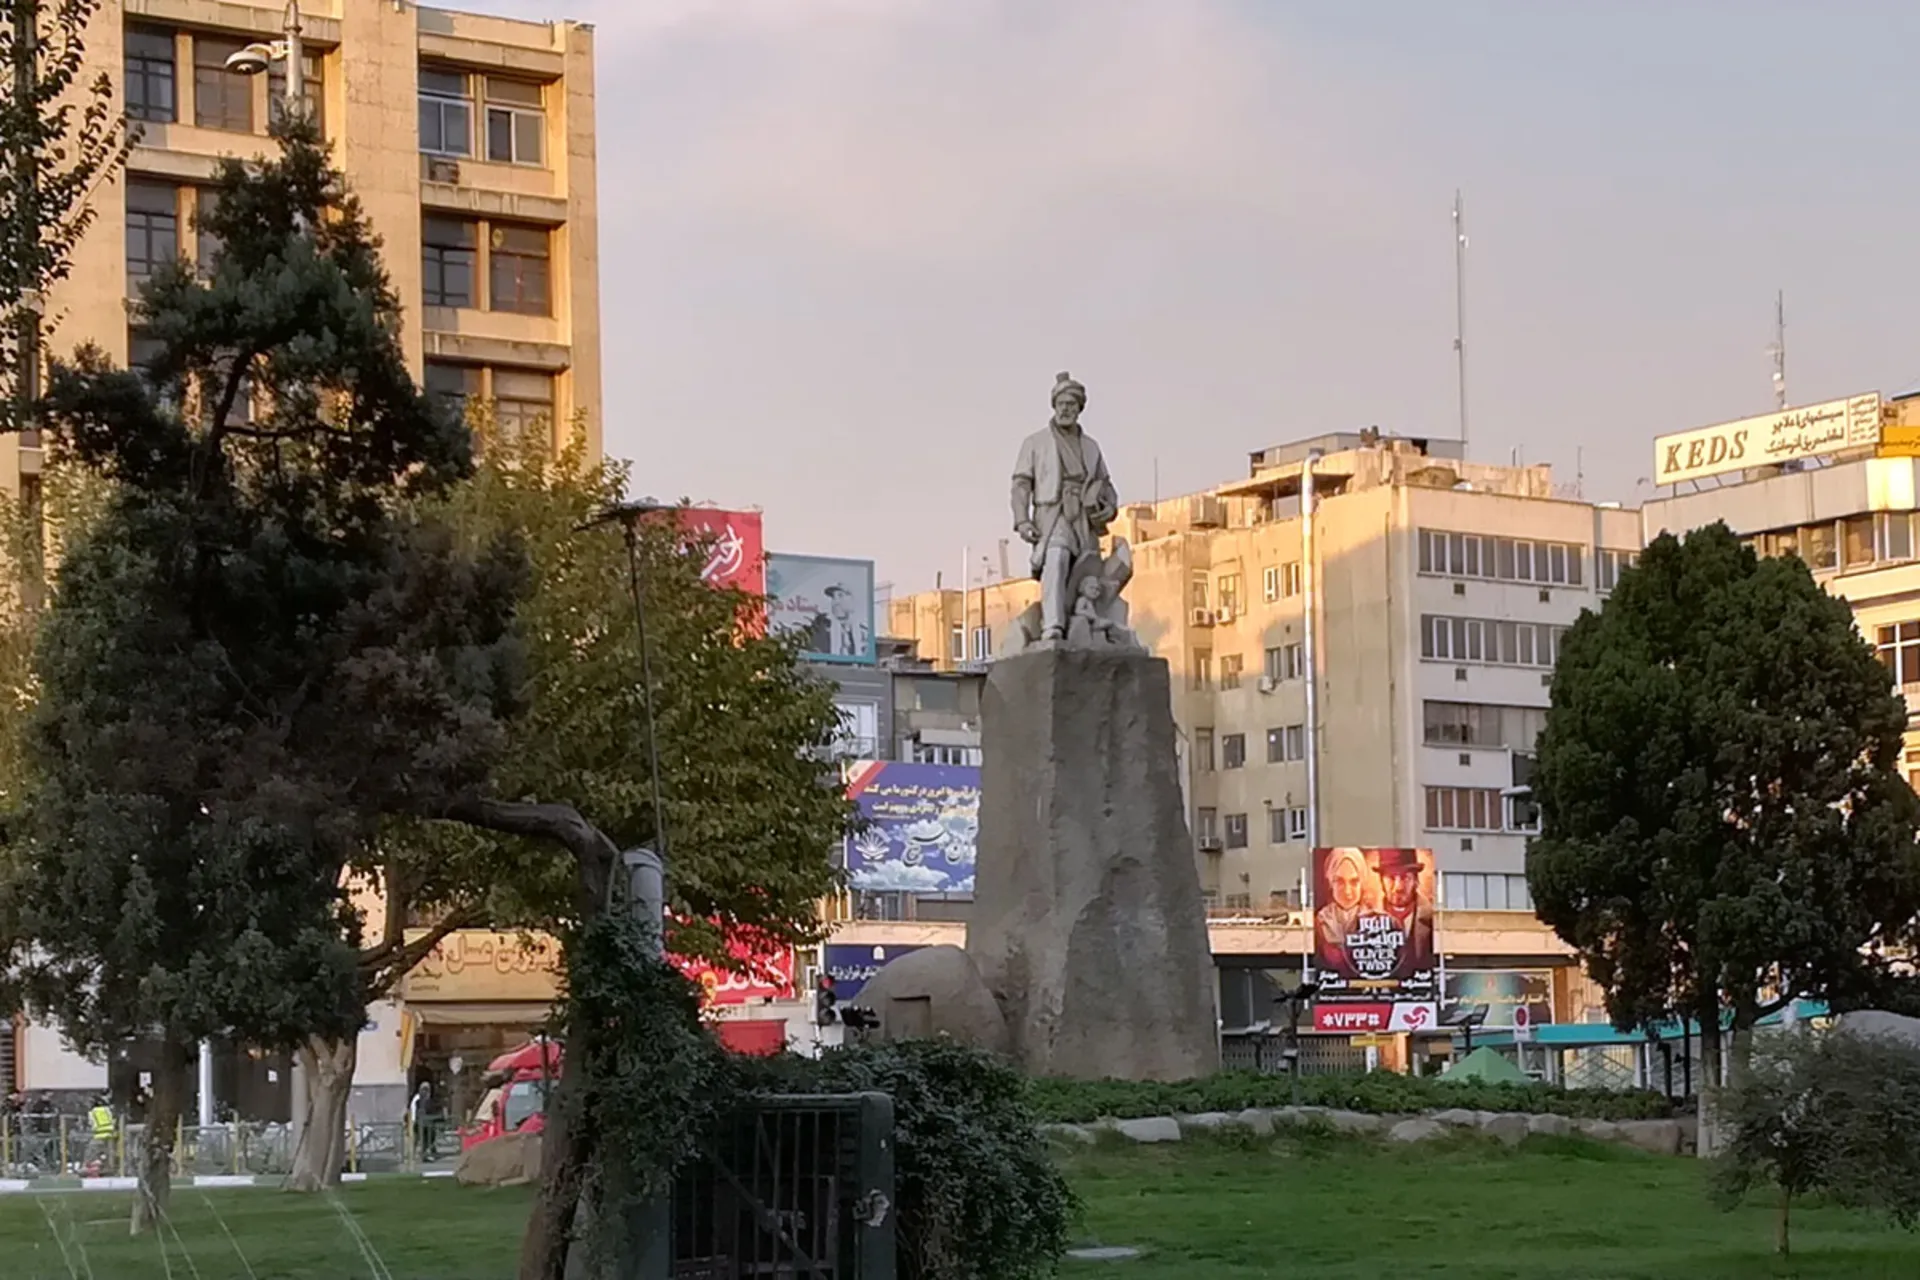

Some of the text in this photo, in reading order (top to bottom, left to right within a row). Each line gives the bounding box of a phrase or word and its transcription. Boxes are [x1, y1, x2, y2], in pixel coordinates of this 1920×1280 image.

[1663, 430, 1748, 474] KEDS
[1352, 948, 1397, 960] OLIVER
[1356, 960, 1394, 971] TWIST
